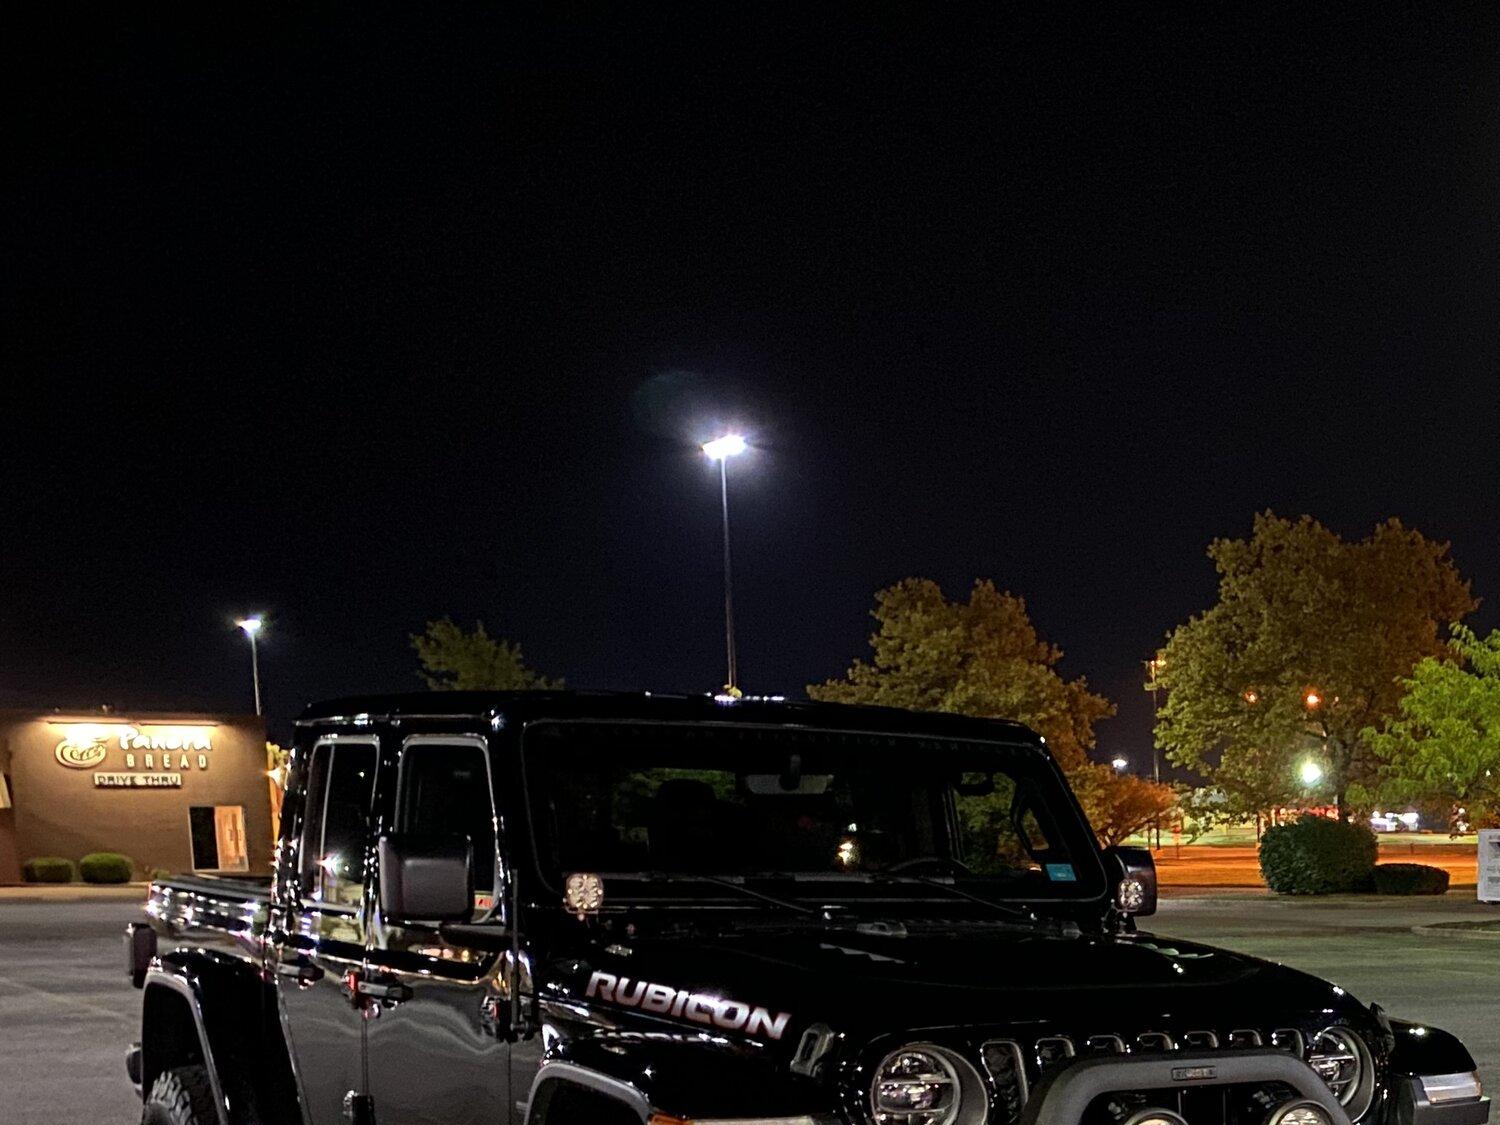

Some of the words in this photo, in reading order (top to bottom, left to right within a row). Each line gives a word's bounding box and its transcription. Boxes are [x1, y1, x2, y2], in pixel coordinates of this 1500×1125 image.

[126, 753, 207, 769] BREAD
[97, 774, 136, 785] DRIVE
[144, 774, 179, 784] THRU
[584, 970, 792, 1040] RUBICON
